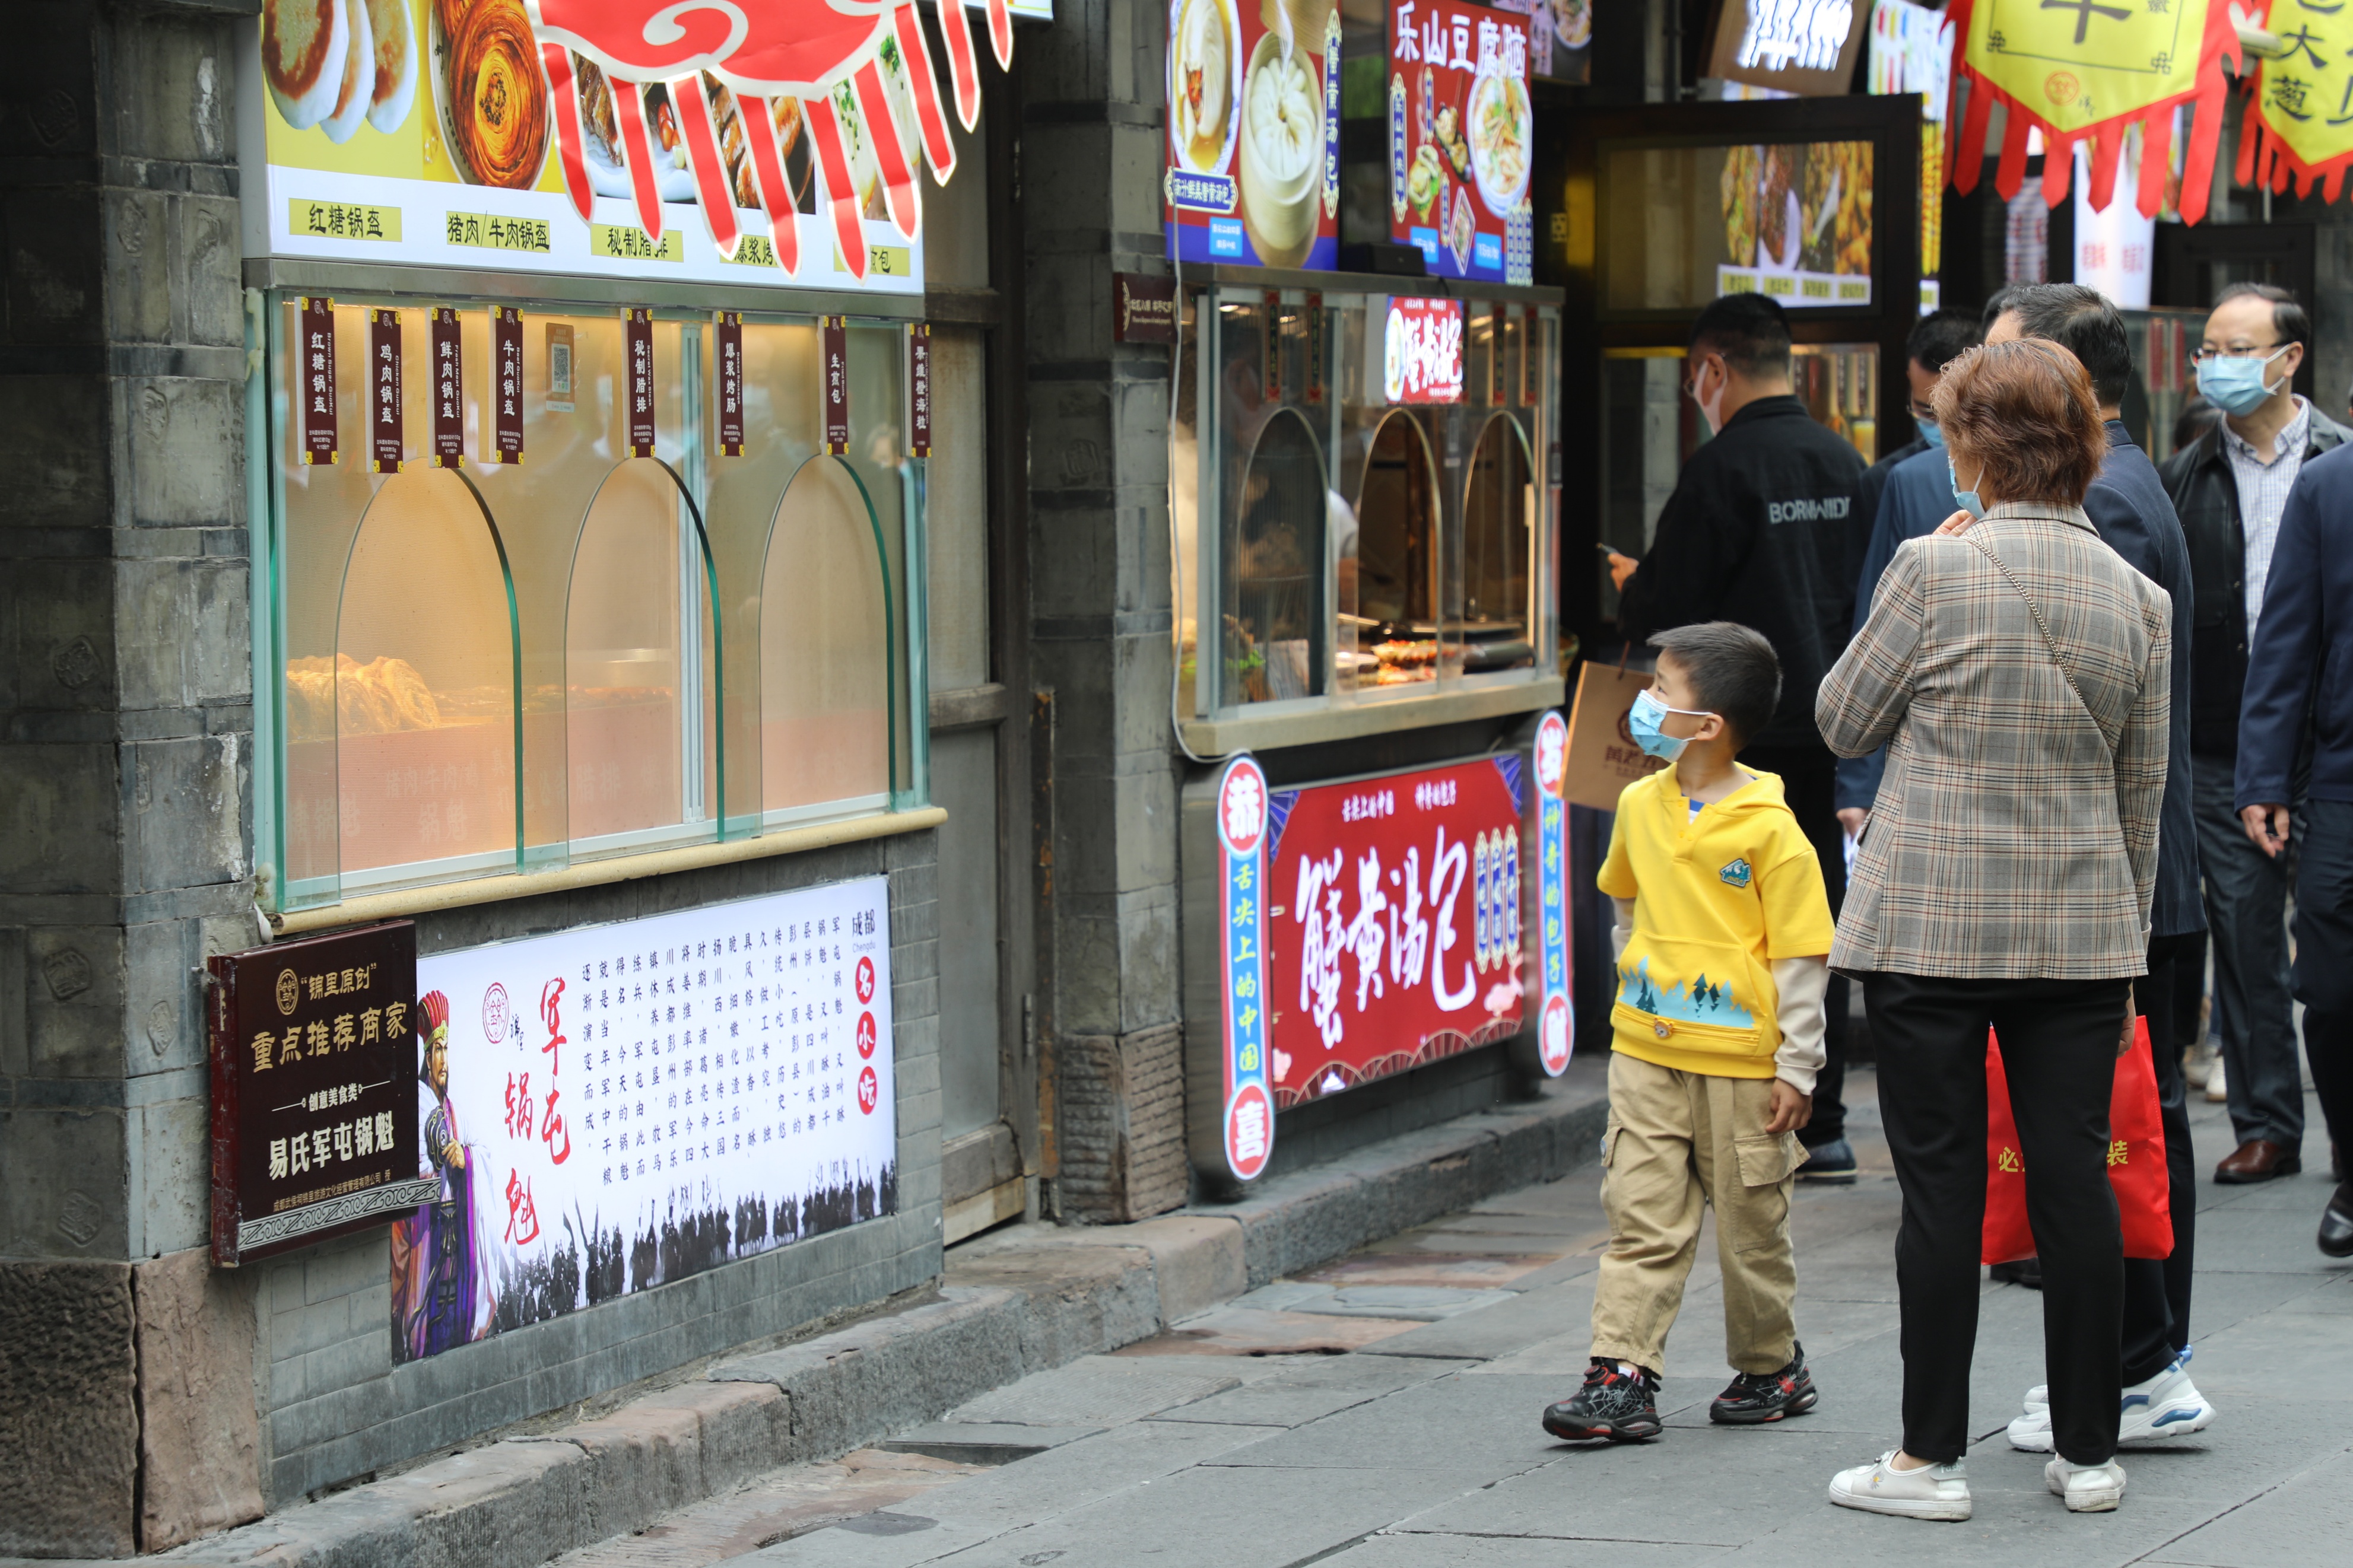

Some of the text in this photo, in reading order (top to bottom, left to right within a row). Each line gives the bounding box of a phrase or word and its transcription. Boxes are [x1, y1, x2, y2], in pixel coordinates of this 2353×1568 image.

[1395, 1, 1527, 78] 乐山豆腐脑
[309, 203, 383, 238] 红糖锅盔
[447, 209, 551, 250] 猪肉/牛肉锅盔
[311, 332, 327, 414] 红糖锅盔
[380, 344, 393, 424] 鸡肉锅盔
[440, 341, 454, 418] 鲜肉锅盔
[503, 339, 515, 416] 牛肉锅盔
[634, 339, 647, 413] 秘制腊排
[725, 342, 735, 414] 爆浆烤肠
[831, 352, 841, 404] 生煎包
[852, 909, 875, 937] 成都
[853, 939, 876, 953] Chengdu
[1232, 863, 1259, 1072] 舌尖上的中国
[251, 1001, 408, 1073] 重点推荐商家
[582, 963, 594, 1148] 逐渐演变而成。
[682, 944, 693, 1162] 将姜维率部在今四
[858, 962, 876, 1106] 名小吃
[309, 1083, 358, 1112] 创意美食类
[599, 960, 612, 1187] 就是当年军中干粮
[268, 1110, 394, 1181] 易氏军屯锅魁
[1234, 1099, 1265, 1163] 喜
